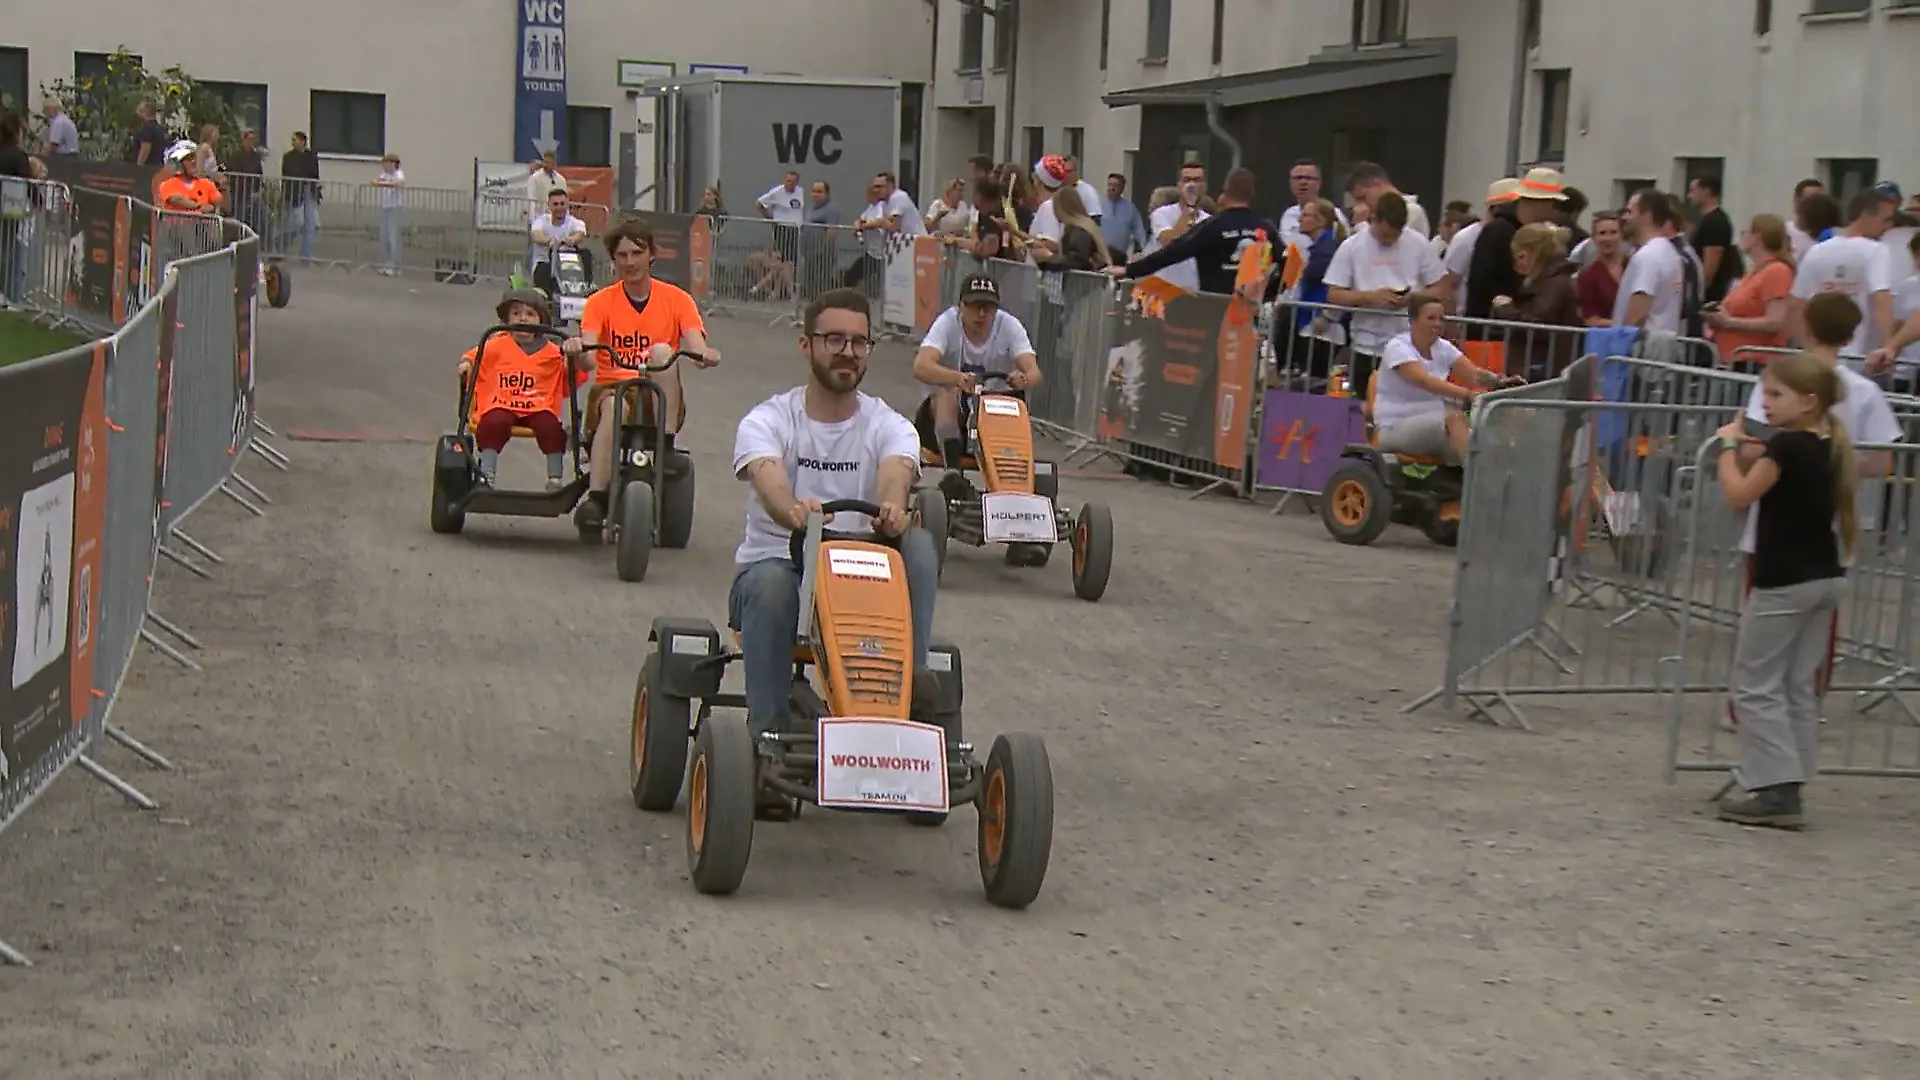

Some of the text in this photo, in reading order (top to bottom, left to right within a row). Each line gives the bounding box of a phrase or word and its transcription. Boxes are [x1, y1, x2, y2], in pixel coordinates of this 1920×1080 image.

[524, 0, 562, 23] WC
[772, 122, 843, 165] WC
[611, 330, 650, 352] help
[499, 371, 534, 391] help
[797, 456, 859, 472] WOOLWORTH
[831, 754, 930, 772] WOOLWORTH
